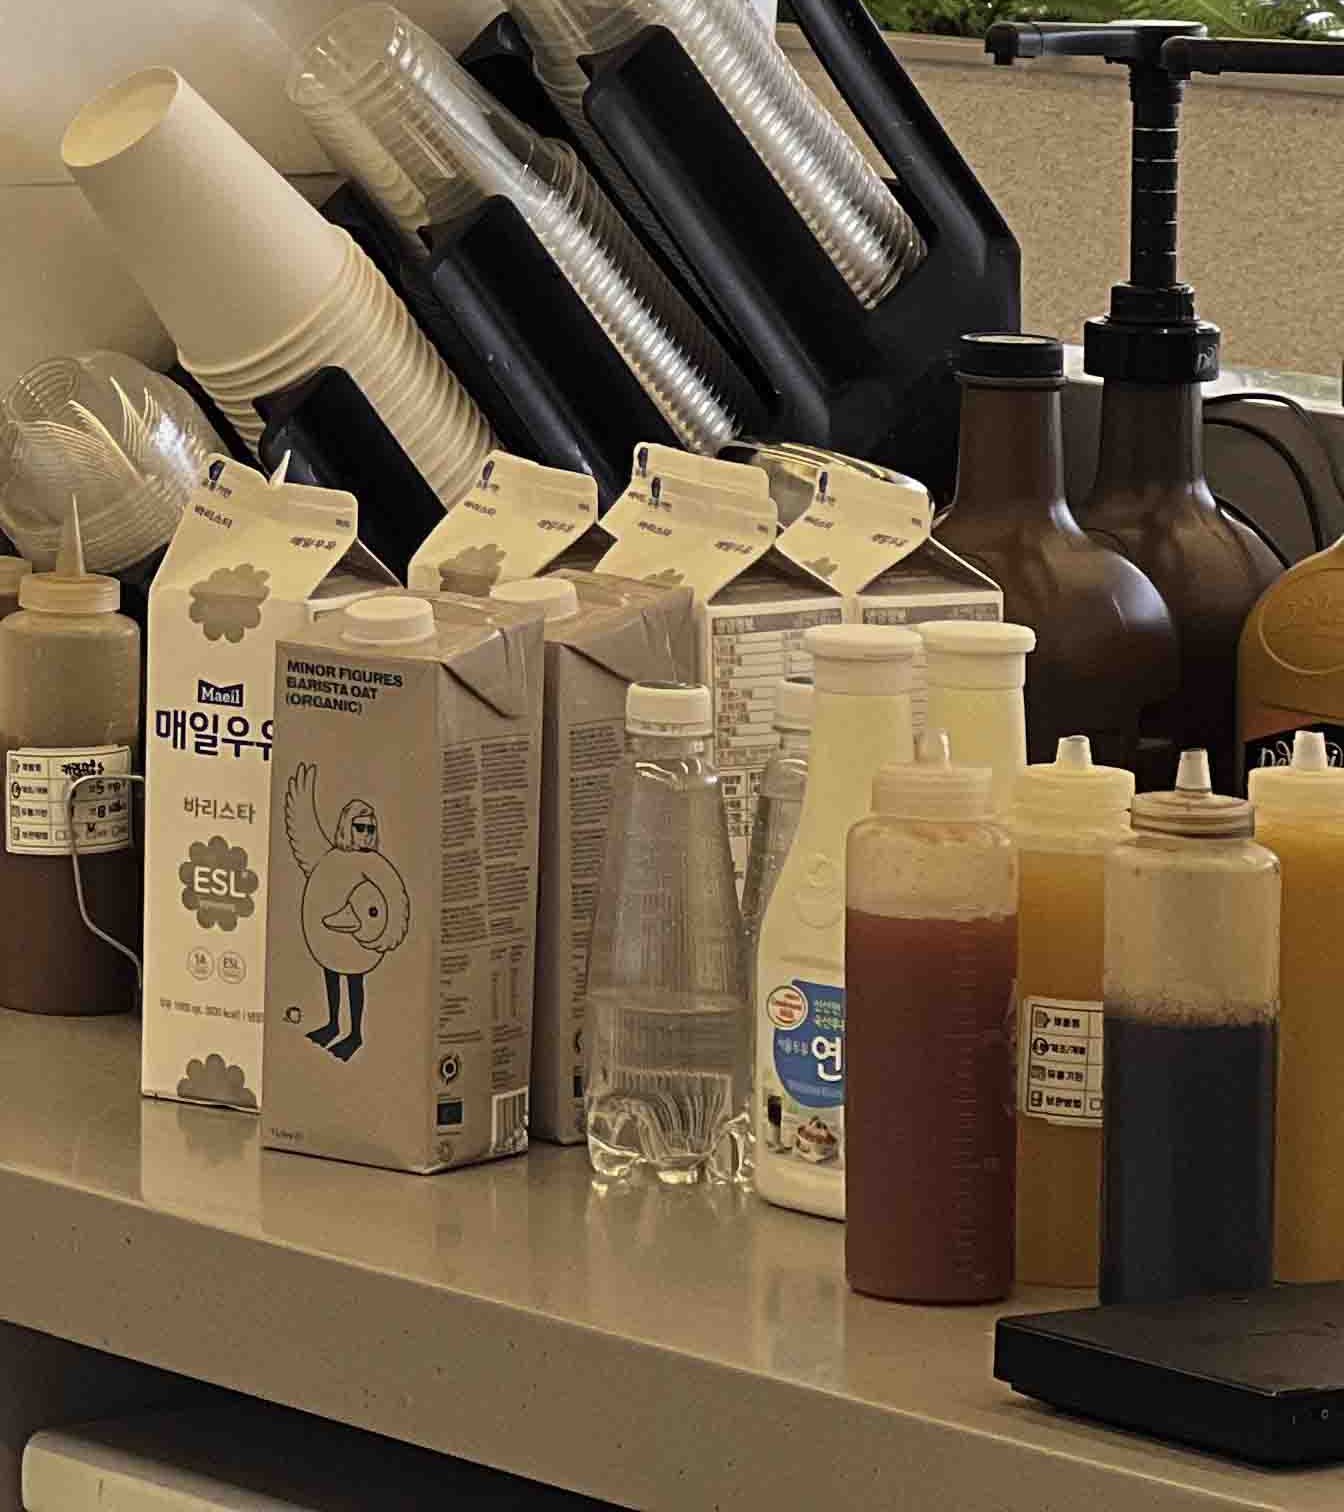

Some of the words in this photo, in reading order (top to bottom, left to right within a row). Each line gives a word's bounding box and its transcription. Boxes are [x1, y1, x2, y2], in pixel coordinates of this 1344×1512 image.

[286, 659, 337, 680] MINOR
[338, 666, 404, 688] FIGURES
[200, 686, 242, 706] Maeil
[285, 675, 349, 697] BARISTA
[349, 685, 379, 701] OAT
[284, 691, 364, 717] (ORGANIC)
[183, 795, 257, 826] 바리스타
[192, 865, 249, 900] ESL
